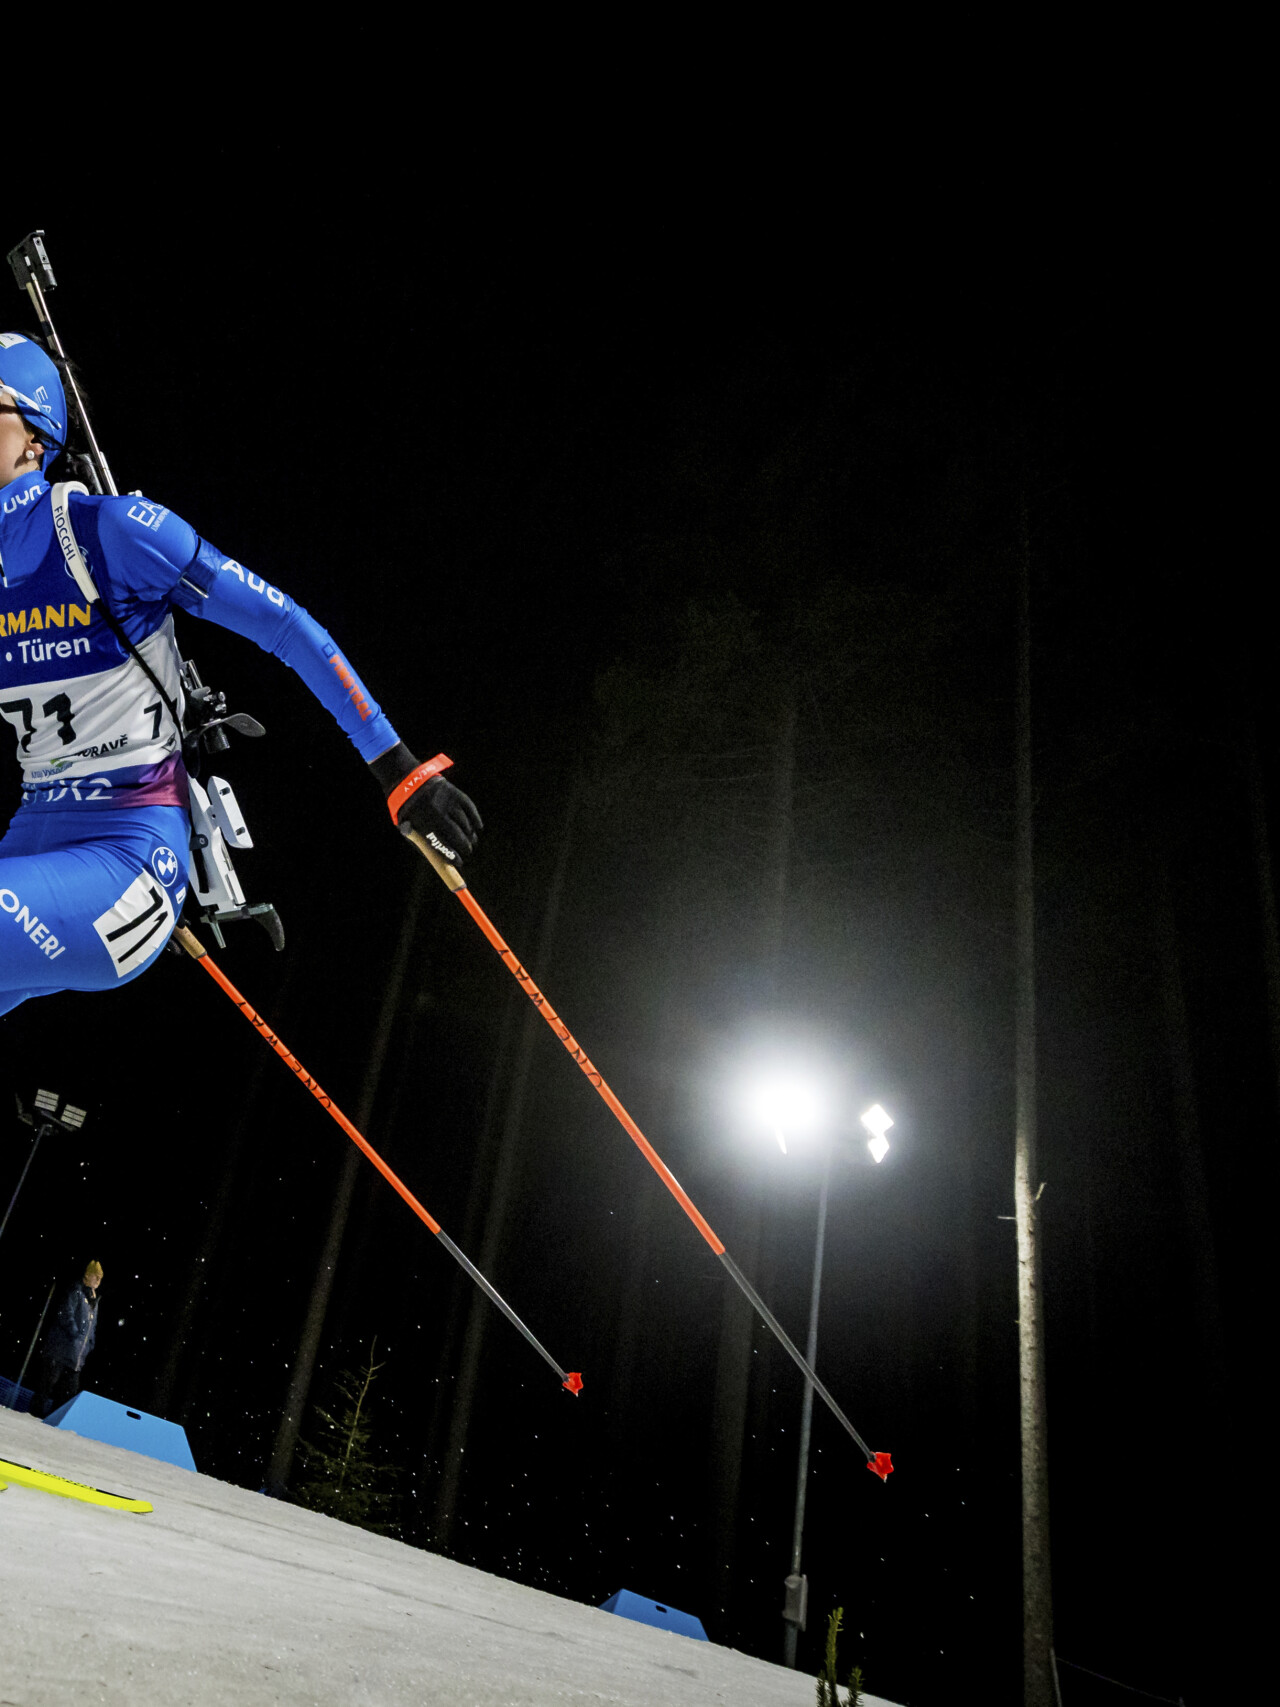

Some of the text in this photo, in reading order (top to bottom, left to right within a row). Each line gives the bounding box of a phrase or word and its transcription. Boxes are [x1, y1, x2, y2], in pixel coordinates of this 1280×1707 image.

[54, 505, 77, 561] FIOCCHI
[18, 638, 91, 664] Türen
[329, 655, 372, 721] FINSTRAL
[74, 733, 128, 757] ORAVĚ
[426, 832, 457, 860] sportful
